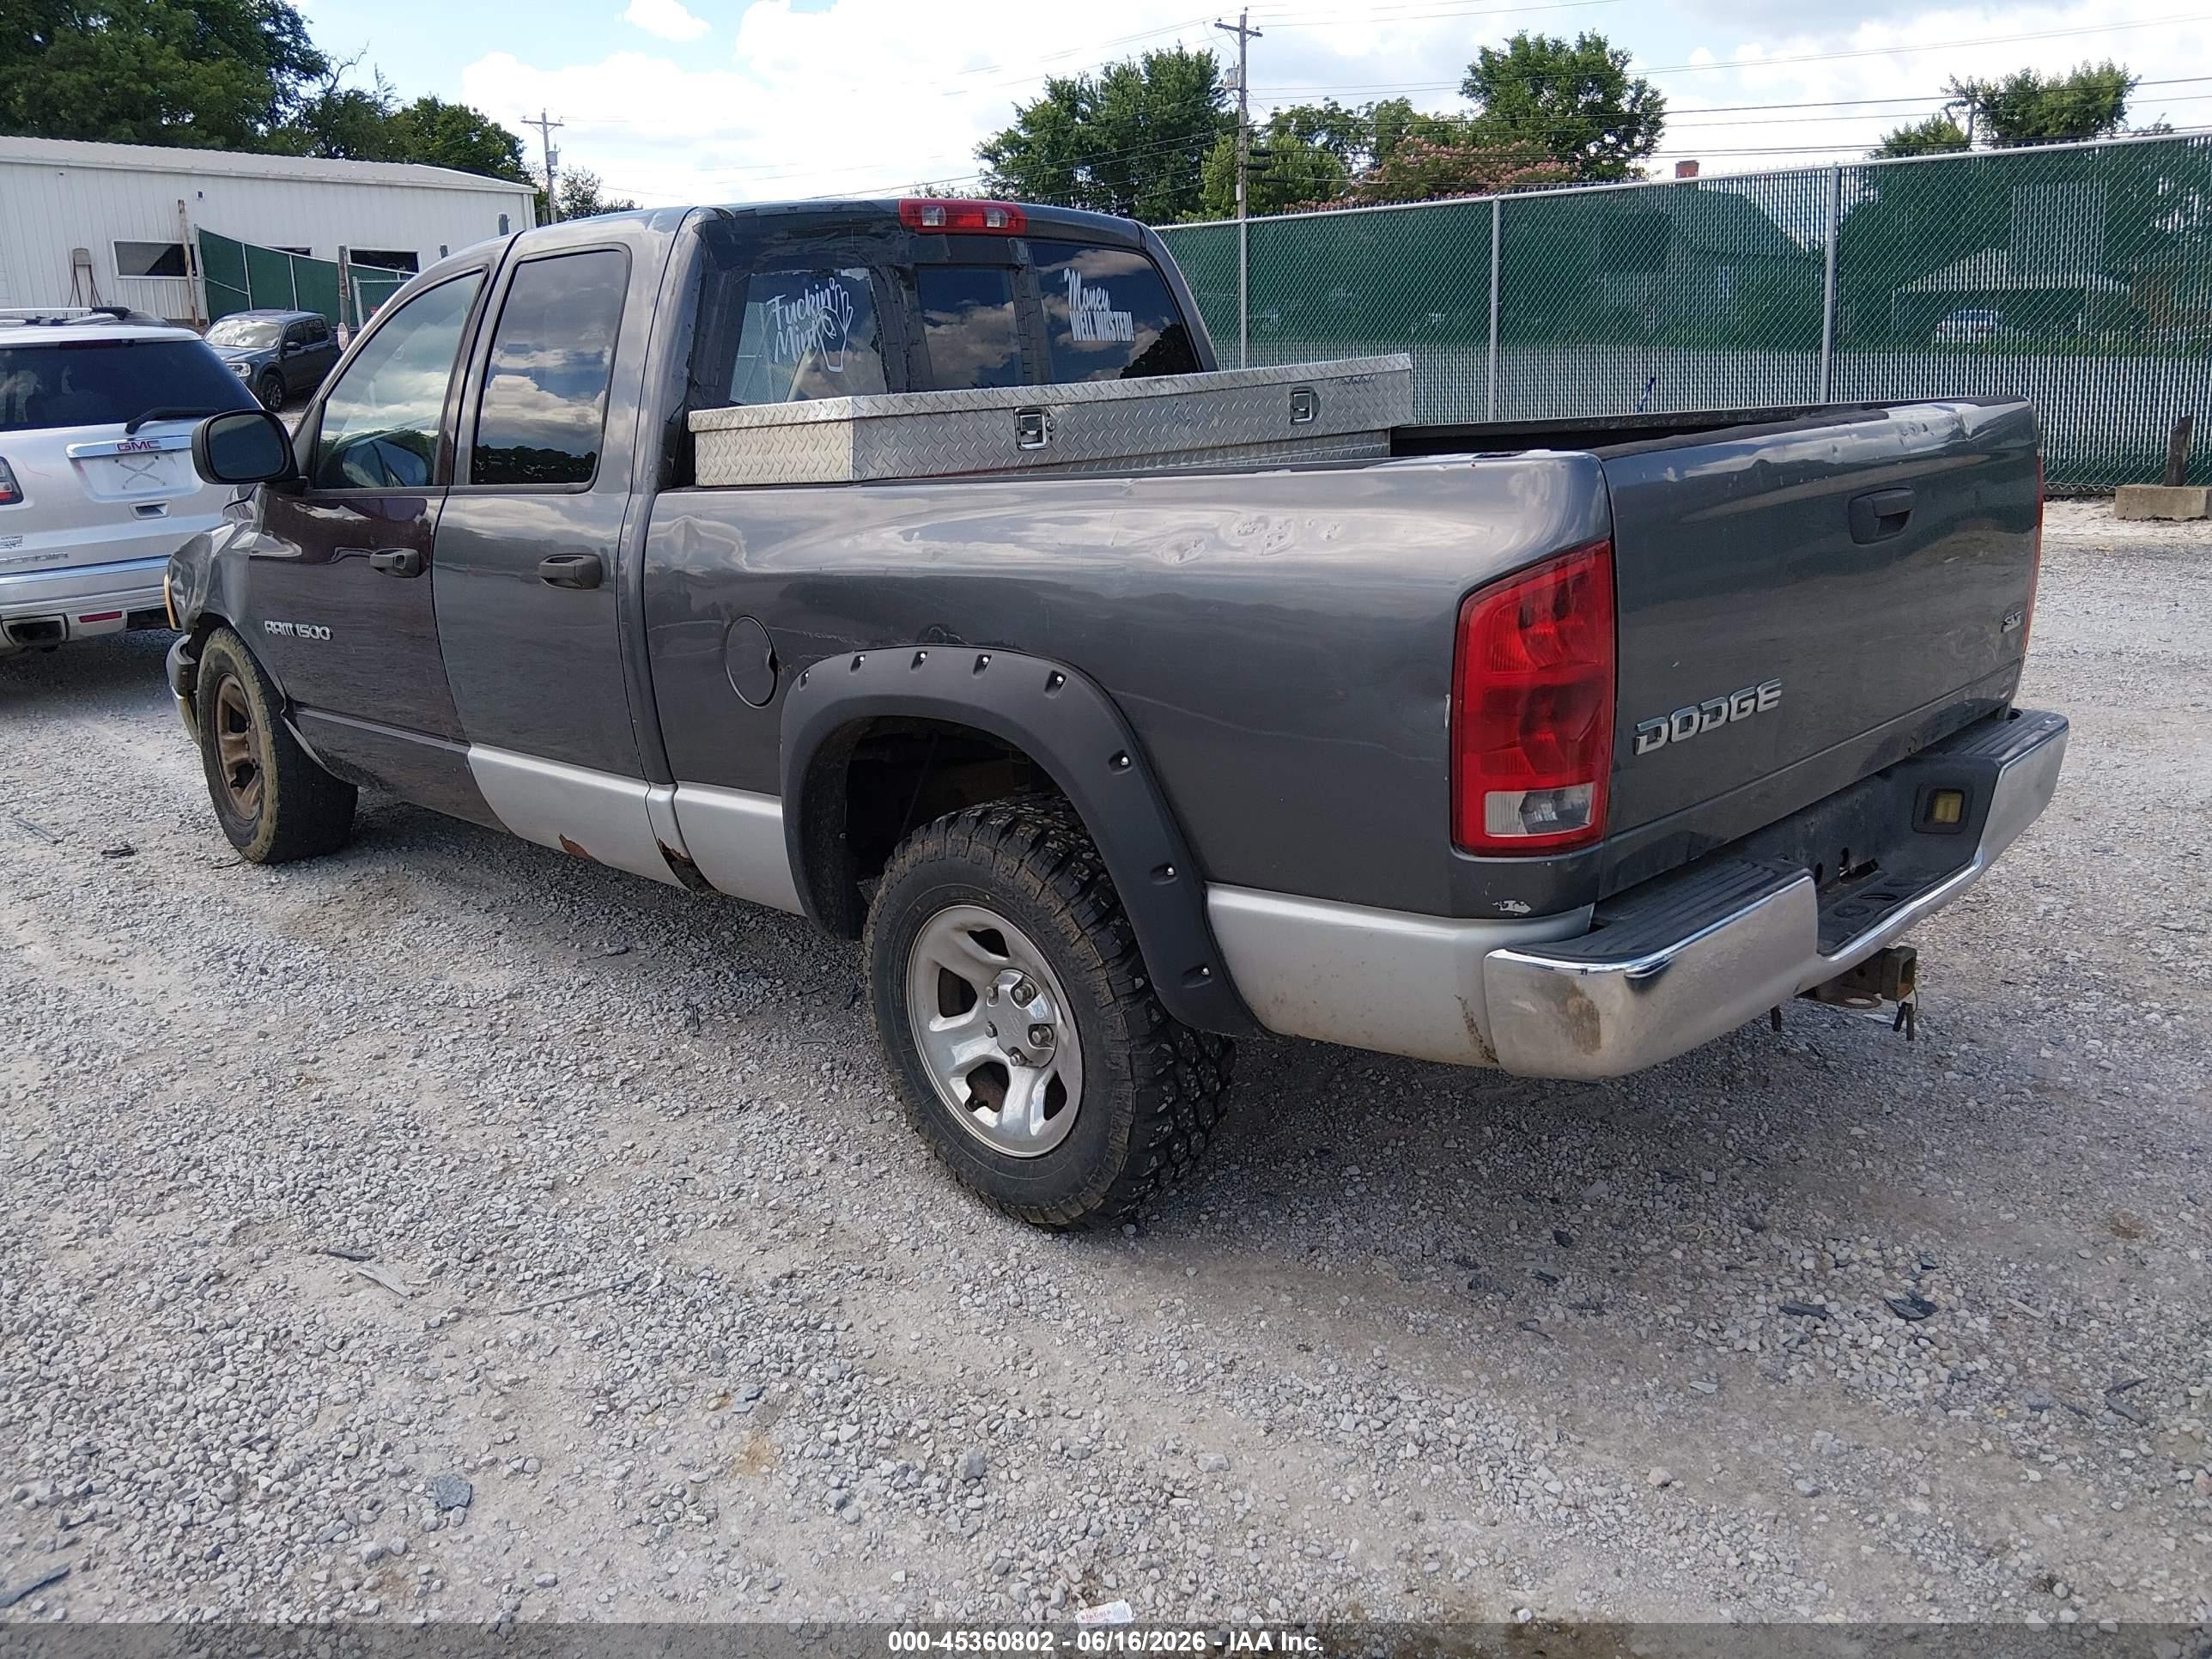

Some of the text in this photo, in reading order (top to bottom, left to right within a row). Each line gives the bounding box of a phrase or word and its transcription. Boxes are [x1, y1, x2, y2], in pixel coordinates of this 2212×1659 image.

[766, 276, 836, 331] Fuckin'
[1063, 267, 1111, 314] Money
[1069, 310, 1135, 342] WELL WASTED!
[116, 440, 162, 453] GMC
[264, 620, 331, 641] RAM 1500
[1635, 678, 1783, 756] DODGE
